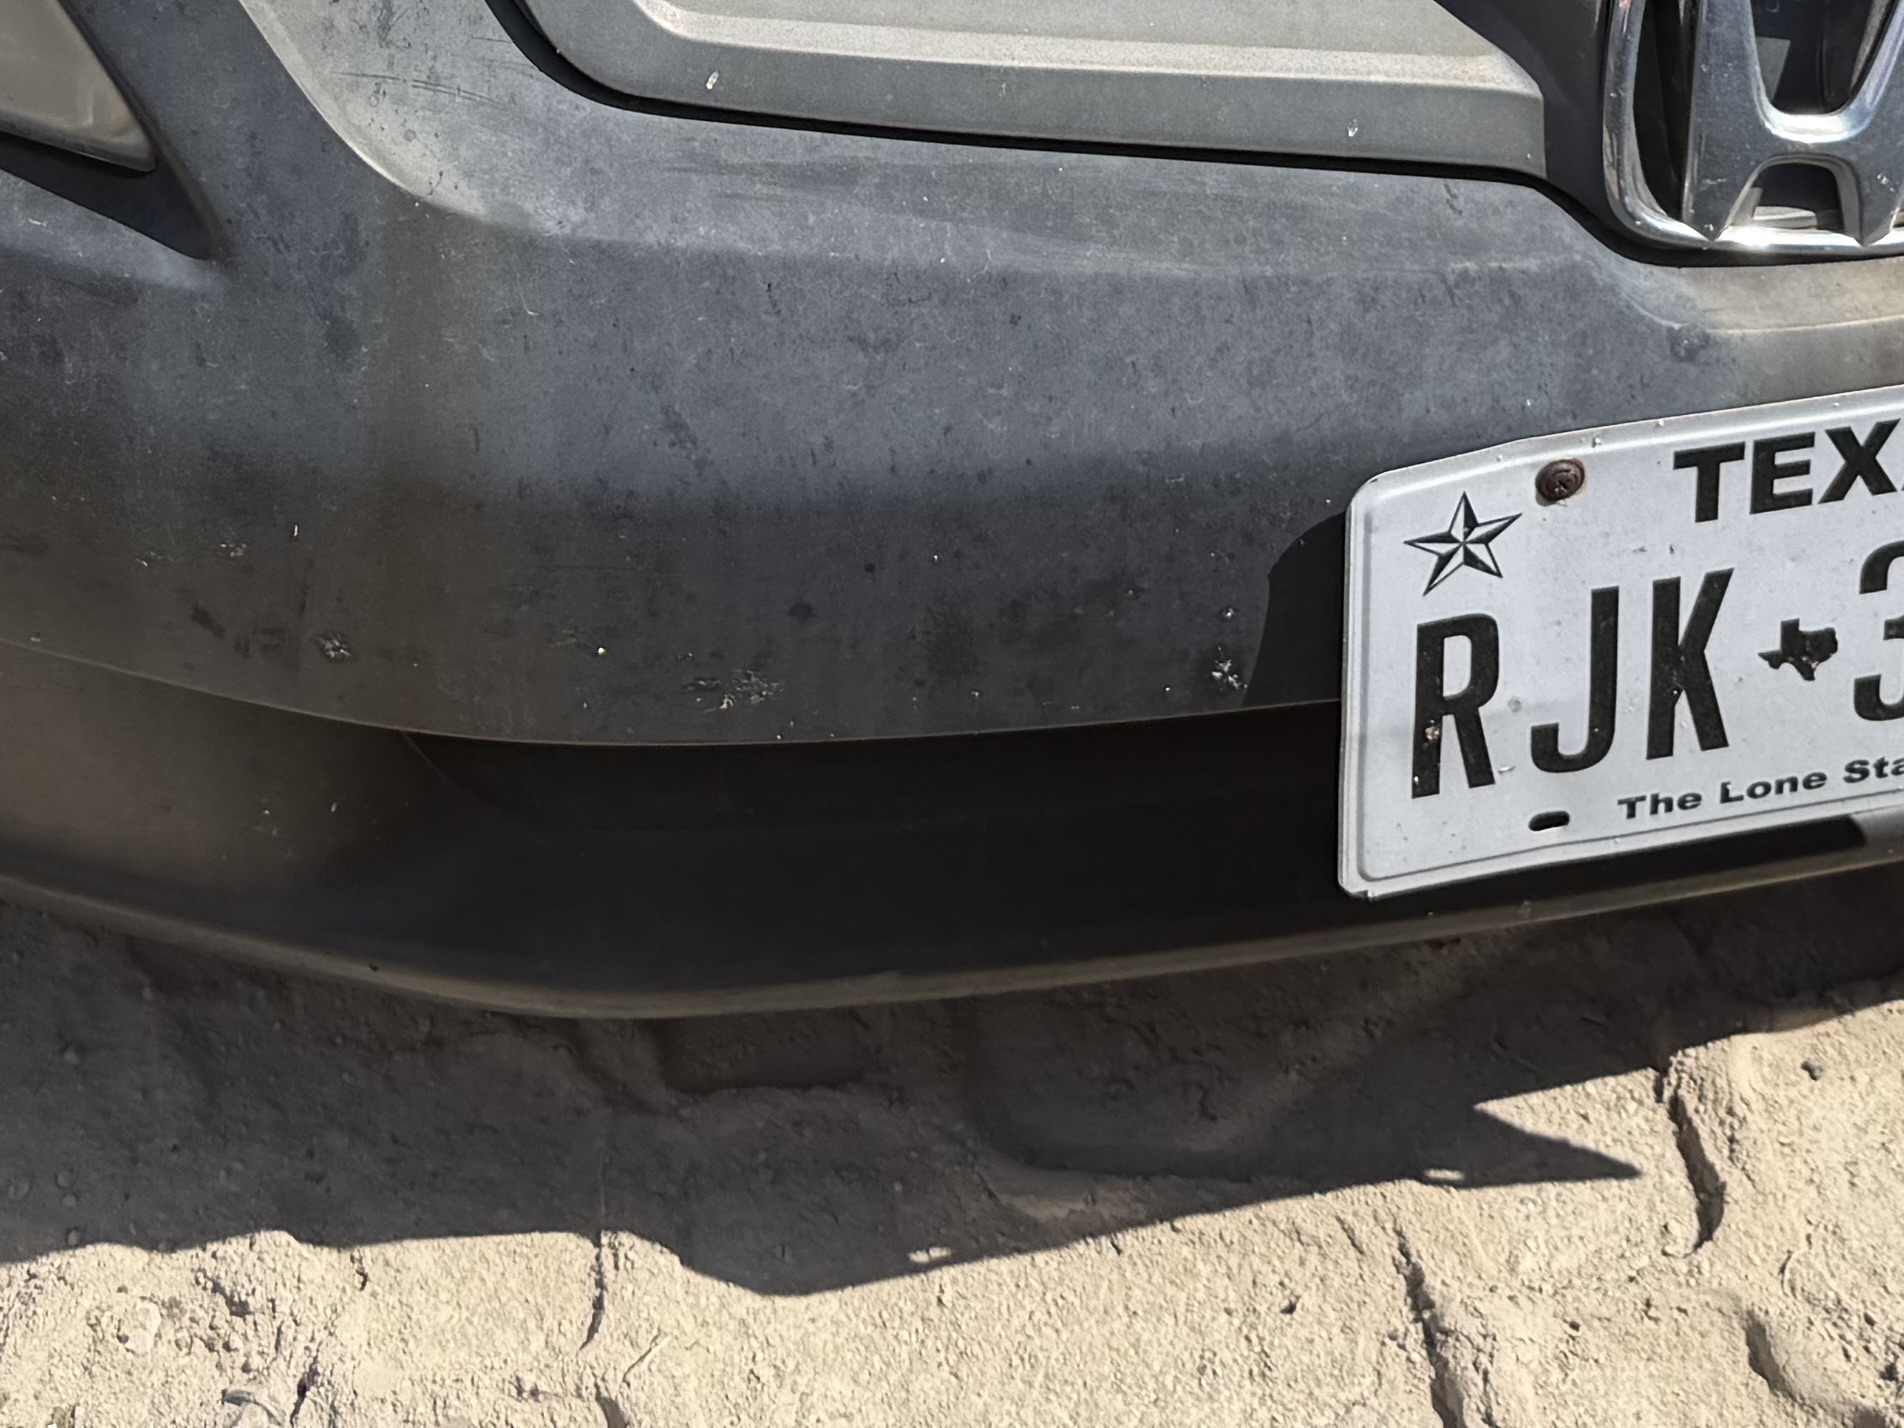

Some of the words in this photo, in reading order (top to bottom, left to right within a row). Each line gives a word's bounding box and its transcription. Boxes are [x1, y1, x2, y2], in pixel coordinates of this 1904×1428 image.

[1411, 568, 1734, 799] RJK
[1617, 790, 1703, 820] The
[1719, 771, 1829, 805] Lone
